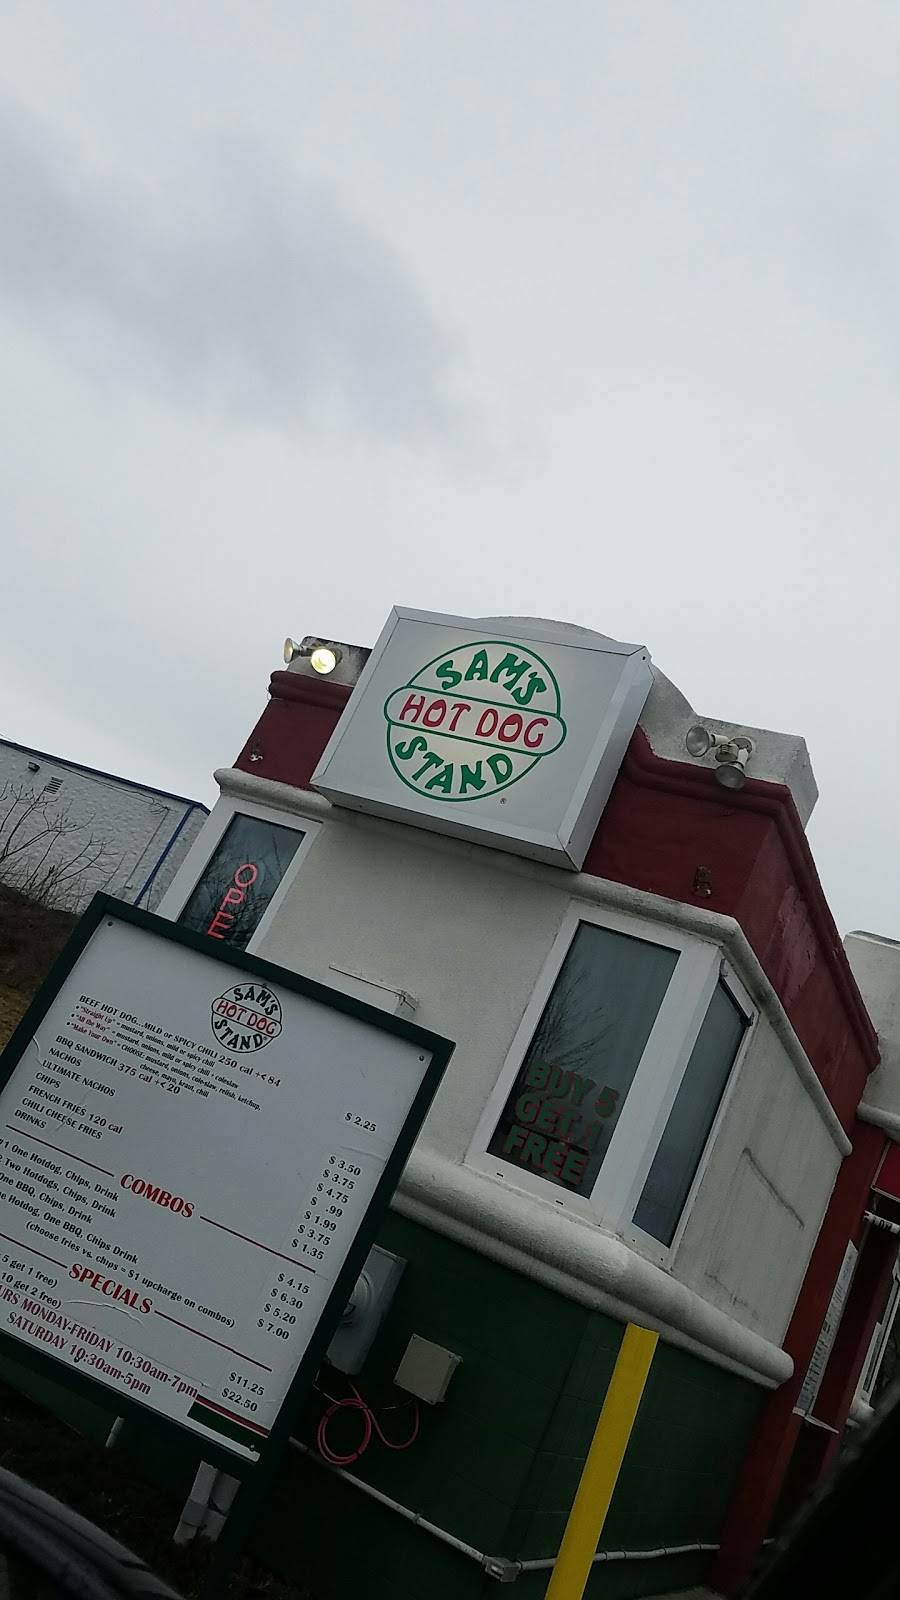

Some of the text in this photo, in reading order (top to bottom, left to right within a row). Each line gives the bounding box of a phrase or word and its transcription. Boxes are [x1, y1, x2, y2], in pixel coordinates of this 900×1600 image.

[436, 649, 547, 705] SAM'S
[399, 694, 549, 748] HOT DOG
[395, 736, 513, 794] STAND
[216, 1000, 277, 1035] HOT DOG
[233, 986, 279, 1015] SAM'S
[48, 1047, 82, 1067] NACHOS
[79, 995, 100, 1008] BEEF
[100, 1004, 118, 1016] HOT
[173, 1035, 197, 1049] SPICY
[197, 1045, 218, 1059] CHILI
[218, 1055, 238, 1068] 250
[239, 1066, 254, 1075] cal
[267, 1076, 281, 1087] 84
[214, 1018, 264, 1051] STAND
[35, 1072, 61, 1089] CHIPS
[42, 1060, 116, 1097] ULTIMATE NACHOS
[55, 1035, 74, 1049] BBQ
[74, 1043, 118, 1067] SANDWICH
[117, 1063, 137, 1076] 375
[138, 1073, 153, 1083] cal
[166, 1083, 181, 1094] 20
[527, 1060, 596, 1107] BUY
[14, 1109, 47, 1129] DRINKS
[22, 1098, 102, 1139] CHILI CHEESE FRIES
[28, 1085, 123, 1134] FRENCH FRIES 120 cal
[515, 1090, 580, 1138] GET
[11, 1144, 29, 1158] One
[94, 1184, 119, 1202] Drink
[504, 1125, 587, 1184] FREE
[5, 1157, 21, 1171] Two
[91, 1200, 116, 1218] Drink
[120, 1174, 195, 1218] COMBOS
[43, 1212, 61, 1226] One
[86, 1233, 111, 1251] Chips
[112, 1246, 138, 1264] Drink
[67, 1206, 92, 1224] Drink
[1, 1254, 58, 1289] 5 get 1 free)
[1, 1272, 61, 1309] 10 get 2 free)
[26, 1221, 59, 1242] (choose
[61, 1237, 80, 1252] fries
[95, 1256, 118, 1271] chips
[142, 1277, 182, 1302] upcharge
[184, 1298, 196, 1308] on
[197, 1305, 235, 1328] combos)
[68, 1263, 153, 1314] SPECIALS
[7, 1311, 151, 1395] SATURDAY 10:30am-5pm
[20, 1298, 114, 1353] MONDAY-FRIDAY
[116, 1347, 203, 1398] 10:30am-7pm
[221, 1388, 258, 1412] $22.50
[229, 1372, 264, 1396] $11.25
